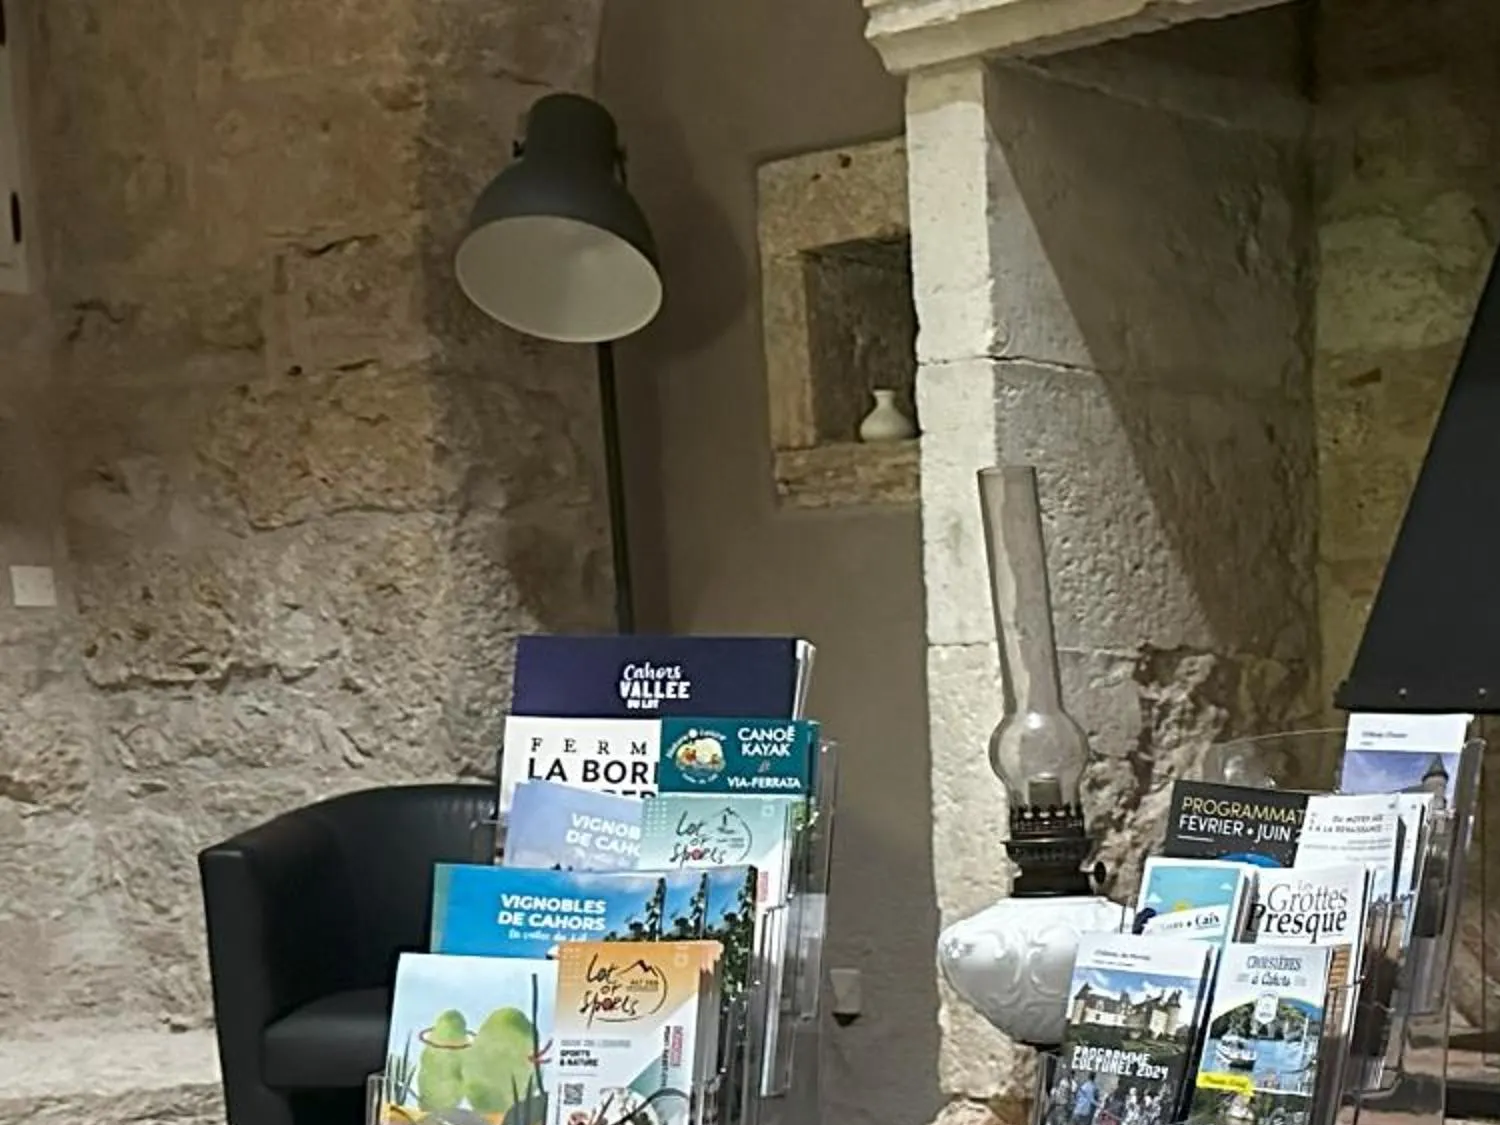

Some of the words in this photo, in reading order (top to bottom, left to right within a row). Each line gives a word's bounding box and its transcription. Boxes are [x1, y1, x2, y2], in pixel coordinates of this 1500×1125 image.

[623, 661, 682, 681] Cahors
[741, 742, 791, 757] KAYAK
[527, 757, 568, 782] LA
[1255, 823, 1292, 843] JUIN
[500, 893, 608, 914] VIGNOBLES
[497, 911, 524, 928] DE
[528, 914, 607, 931] CAHORS
